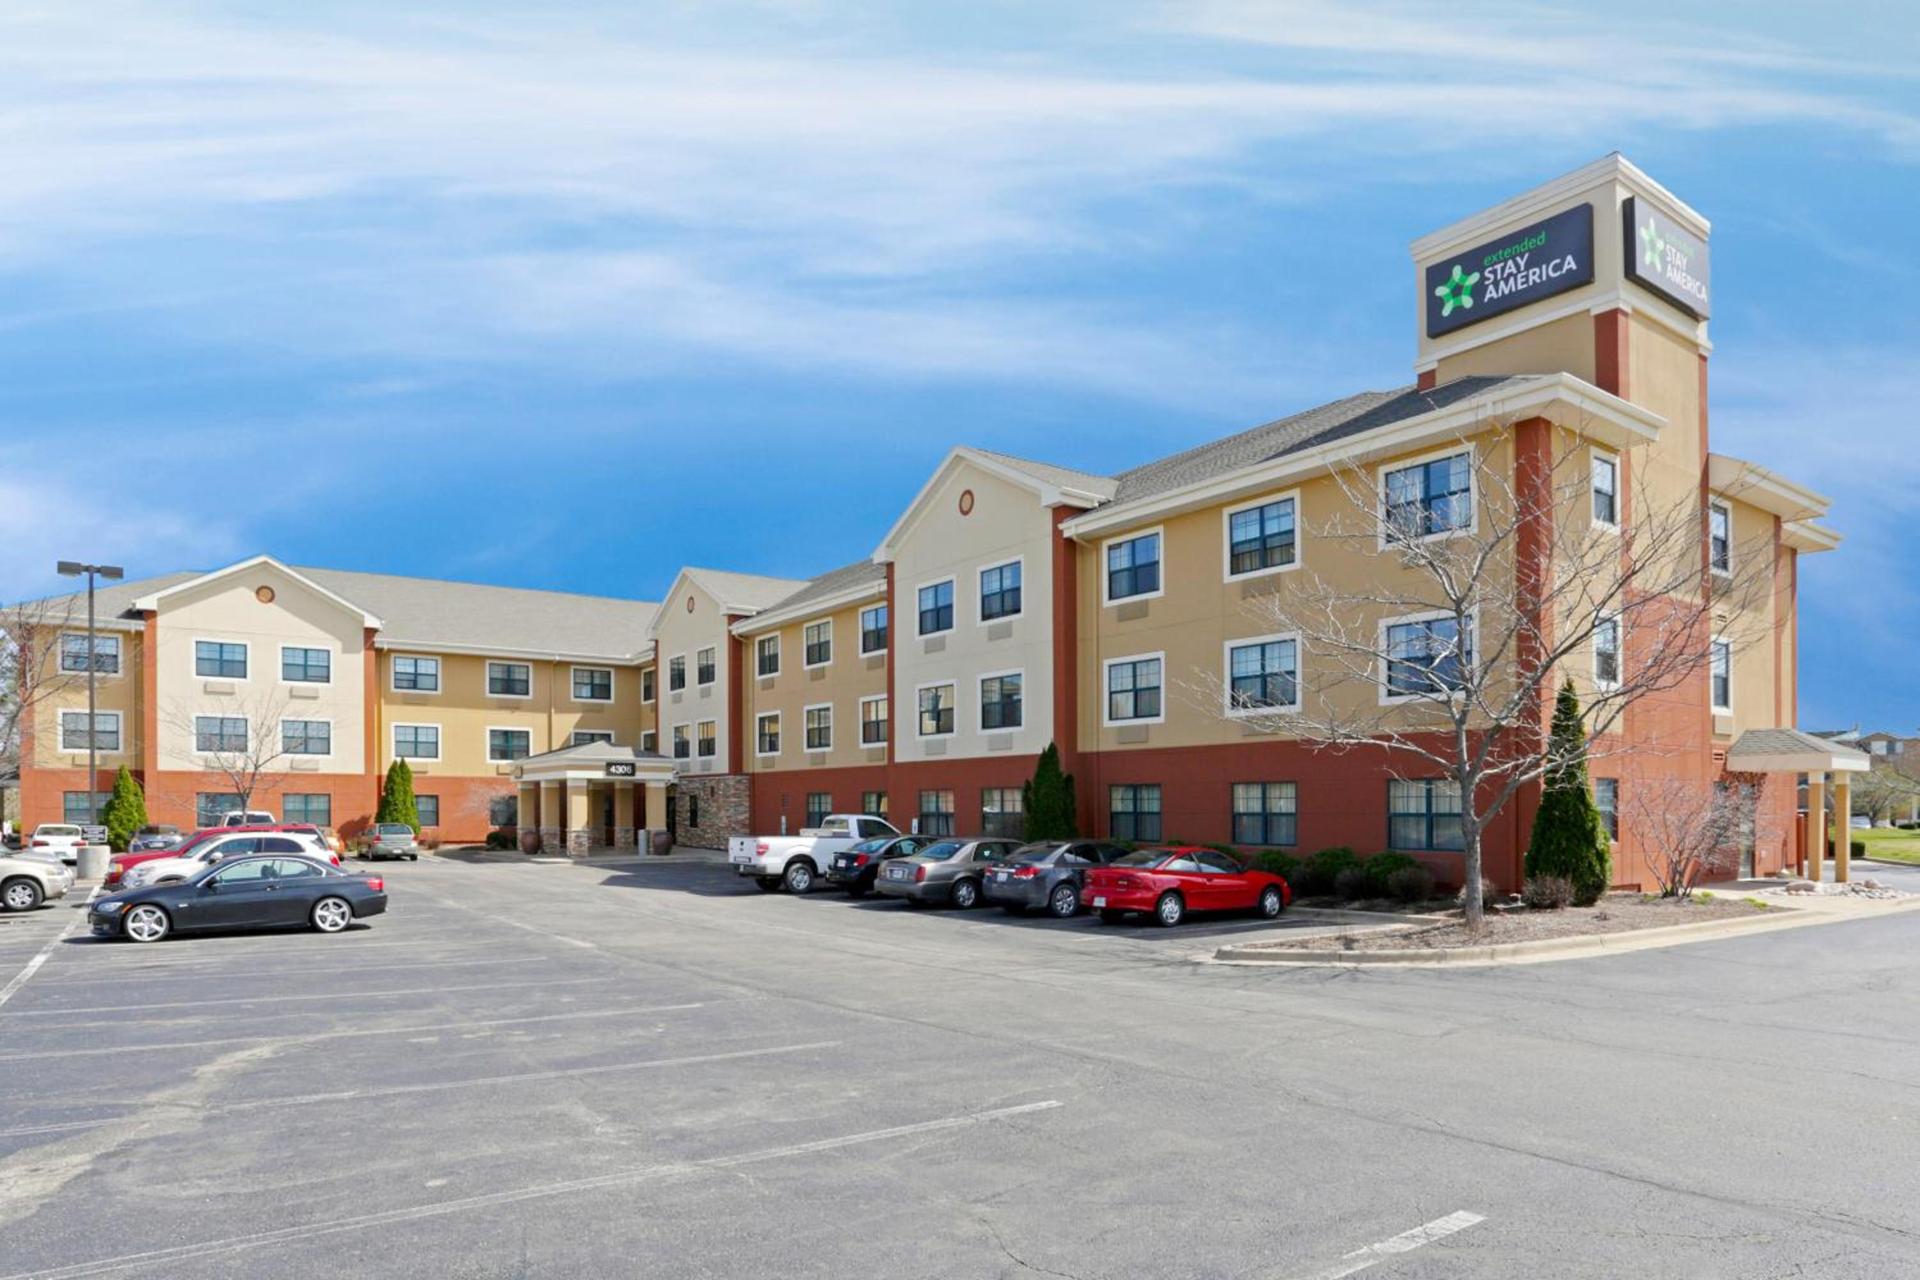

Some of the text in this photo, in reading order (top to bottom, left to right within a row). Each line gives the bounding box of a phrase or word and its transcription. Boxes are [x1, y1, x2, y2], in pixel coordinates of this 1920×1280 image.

[1484, 231, 1546, 266] extended
[1665, 244, 1688, 271] STAY
[1484, 252, 1529, 285] STAY
[1484, 254, 1577, 303] AMERICA
[1666, 263, 1708, 303] AMERICA
